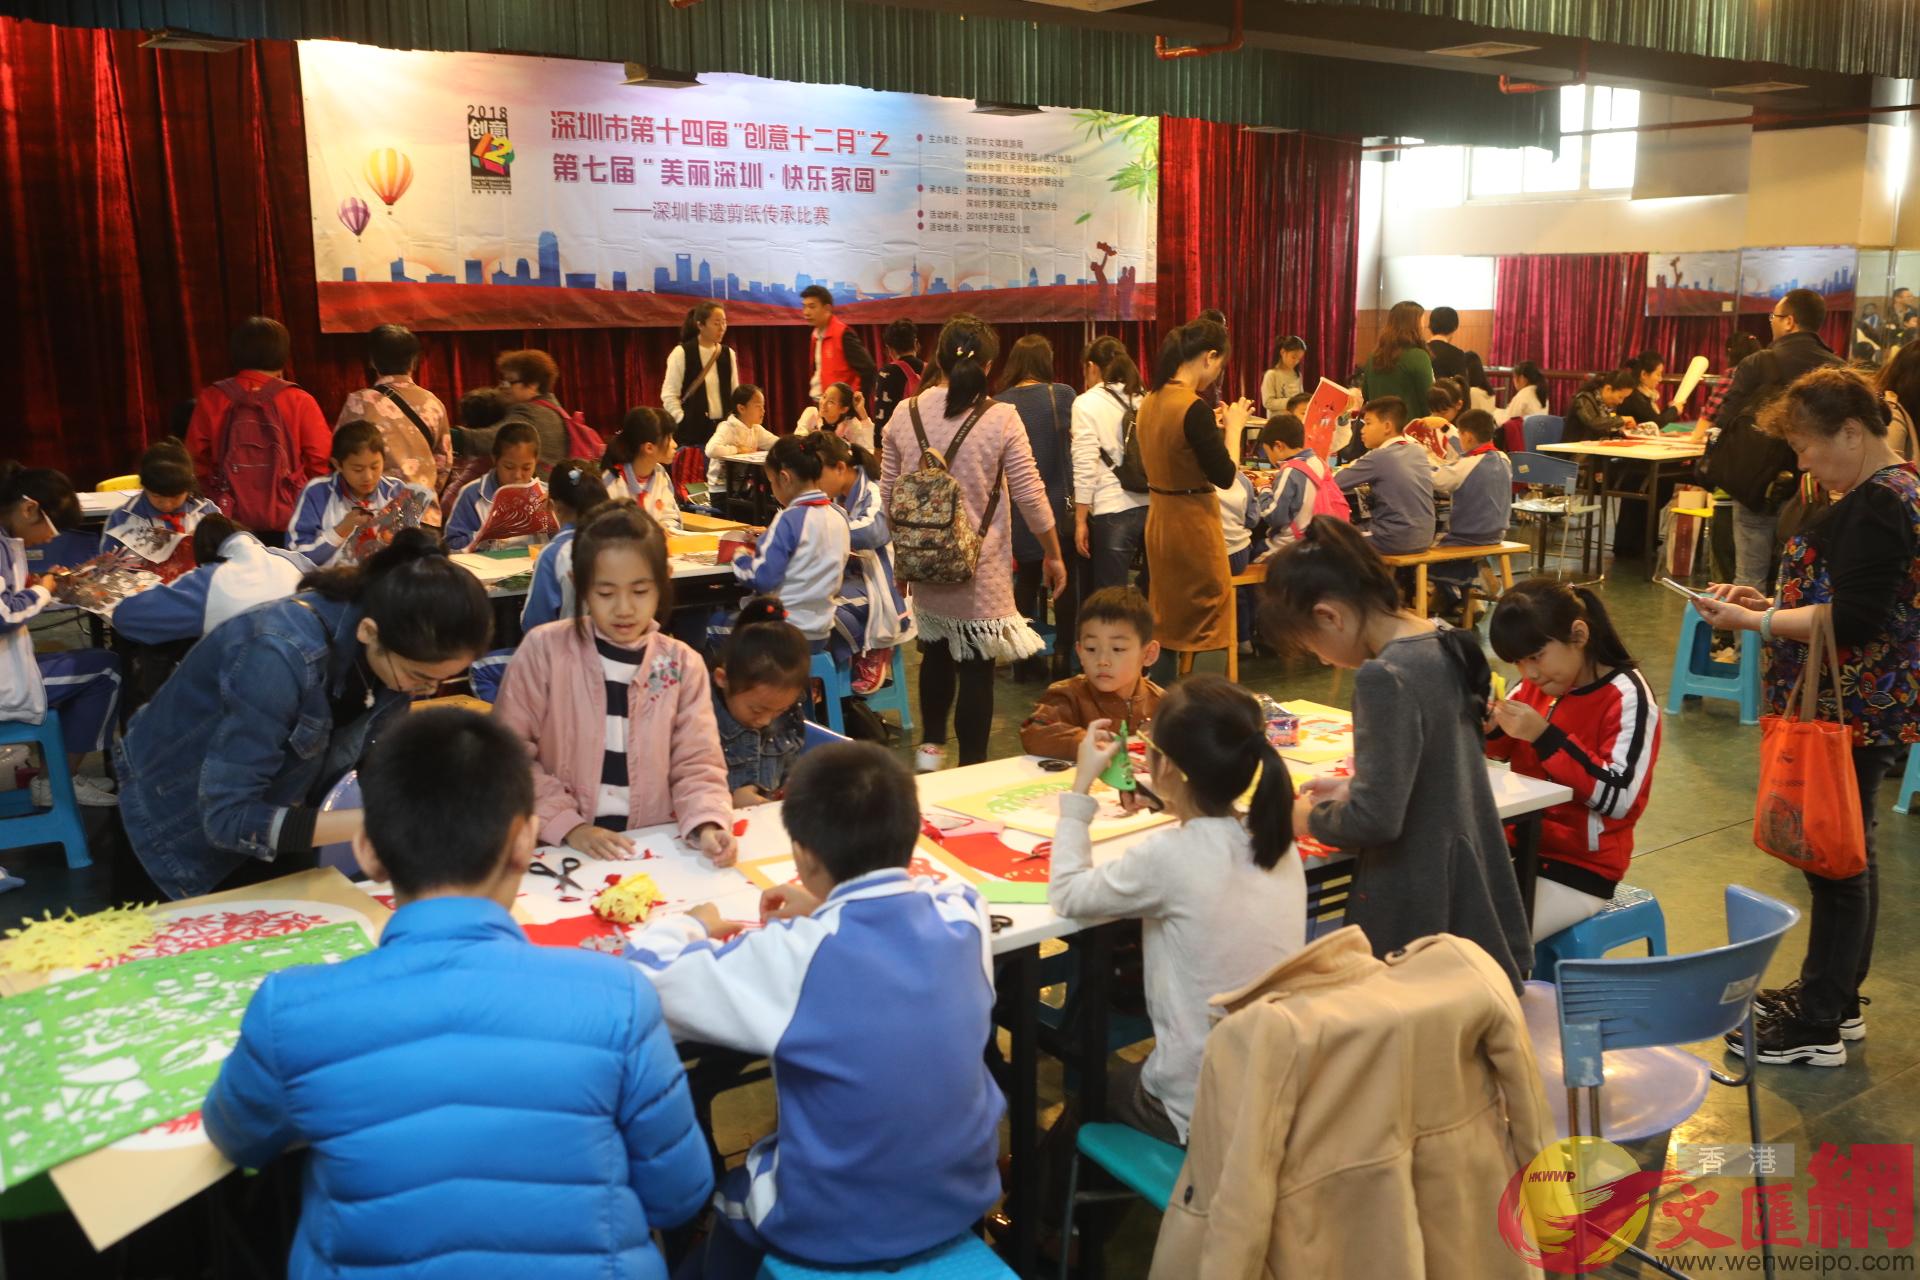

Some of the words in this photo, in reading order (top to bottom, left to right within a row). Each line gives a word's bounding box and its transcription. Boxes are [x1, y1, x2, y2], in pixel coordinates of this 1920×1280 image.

[467, 104, 508, 119] 2018
[469, 119, 507, 140] 创意
[550, 110, 891, 157] 深圳市第十四届“创意十二月”之
